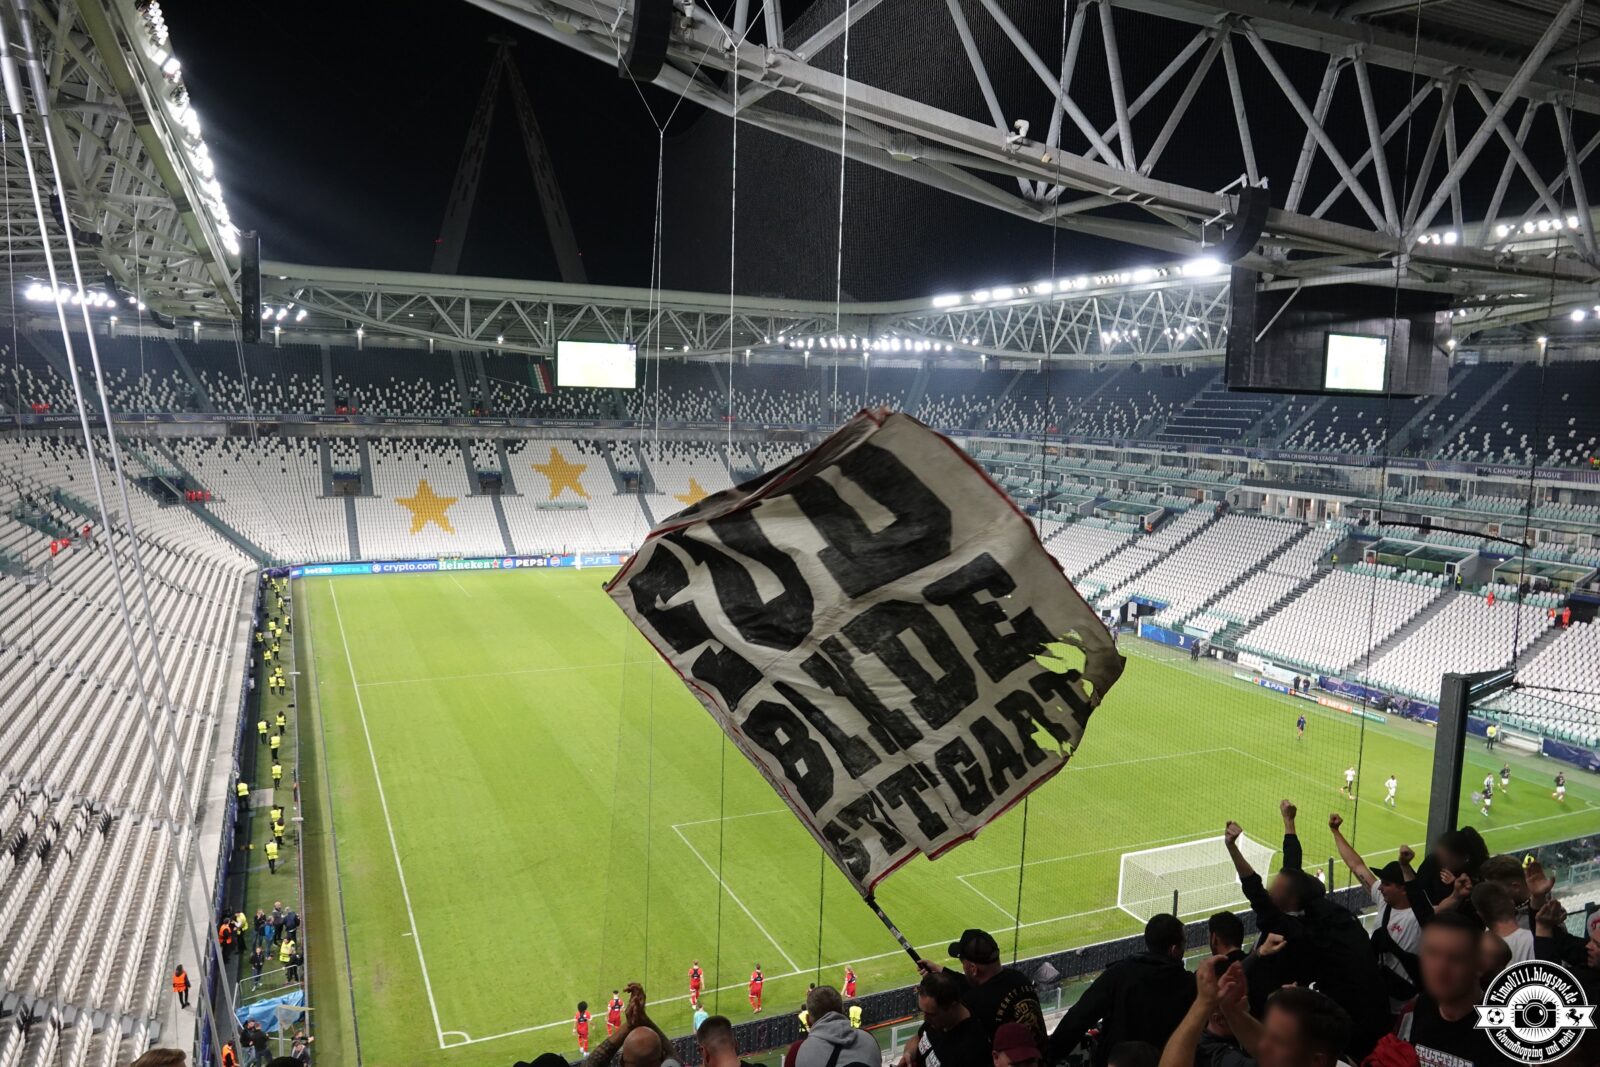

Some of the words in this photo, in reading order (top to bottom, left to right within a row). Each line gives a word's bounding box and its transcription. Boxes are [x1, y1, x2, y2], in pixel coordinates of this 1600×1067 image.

[1319, 455, 1339, 463] LEAGUE
[1493, 468, 1533, 477] CHAMPIONS
[1534, 470, 1561, 479] LEAGUE
[438, 560, 490, 570] Heineken
[516, 558, 548, 567] PEPSI
[583, 556, 612, 565] PS5
[383, 562, 437, 572] crypto.com
